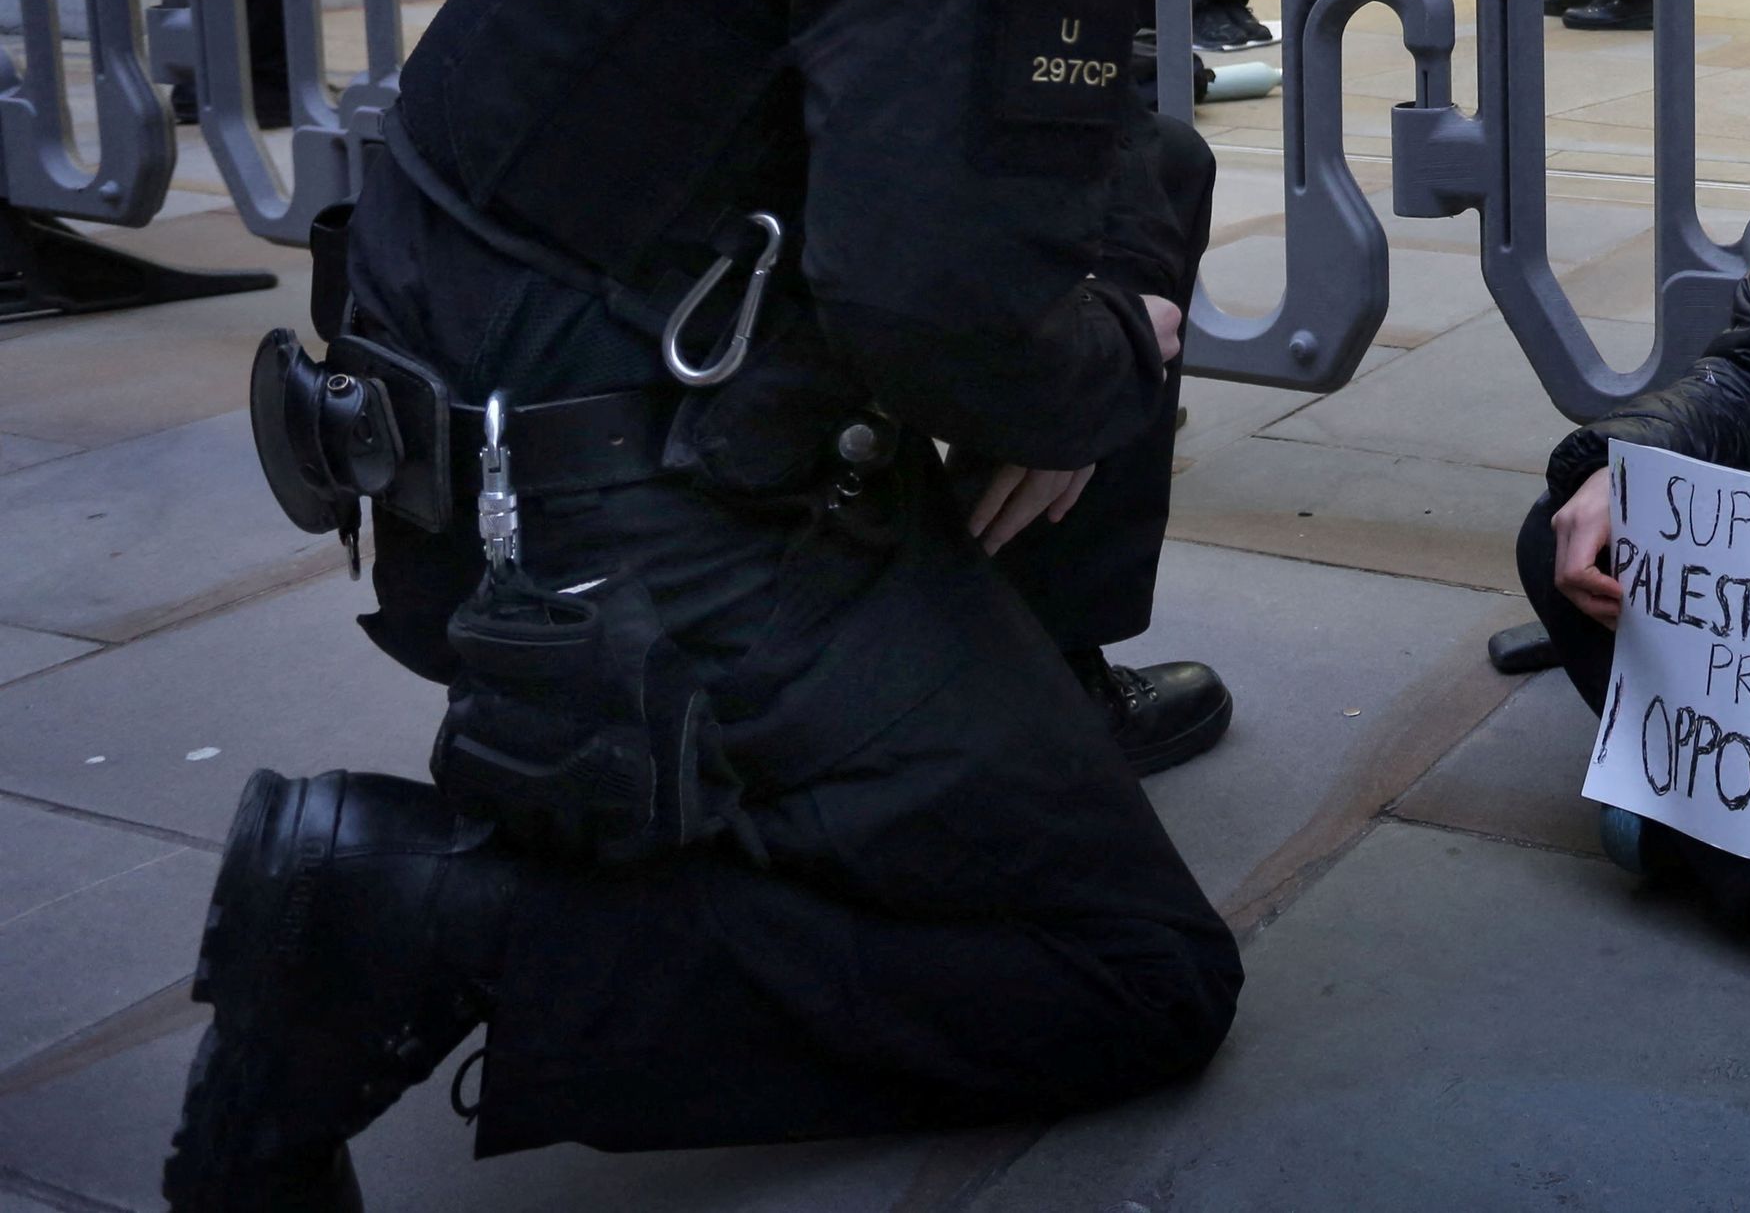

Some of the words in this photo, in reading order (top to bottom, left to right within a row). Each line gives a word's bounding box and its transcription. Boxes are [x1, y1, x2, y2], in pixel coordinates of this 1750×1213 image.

[1061, 18, 1080, 43] U
[1032, 56, 1118, 87] 297CP
[1612, 456, 1628, 524] I
